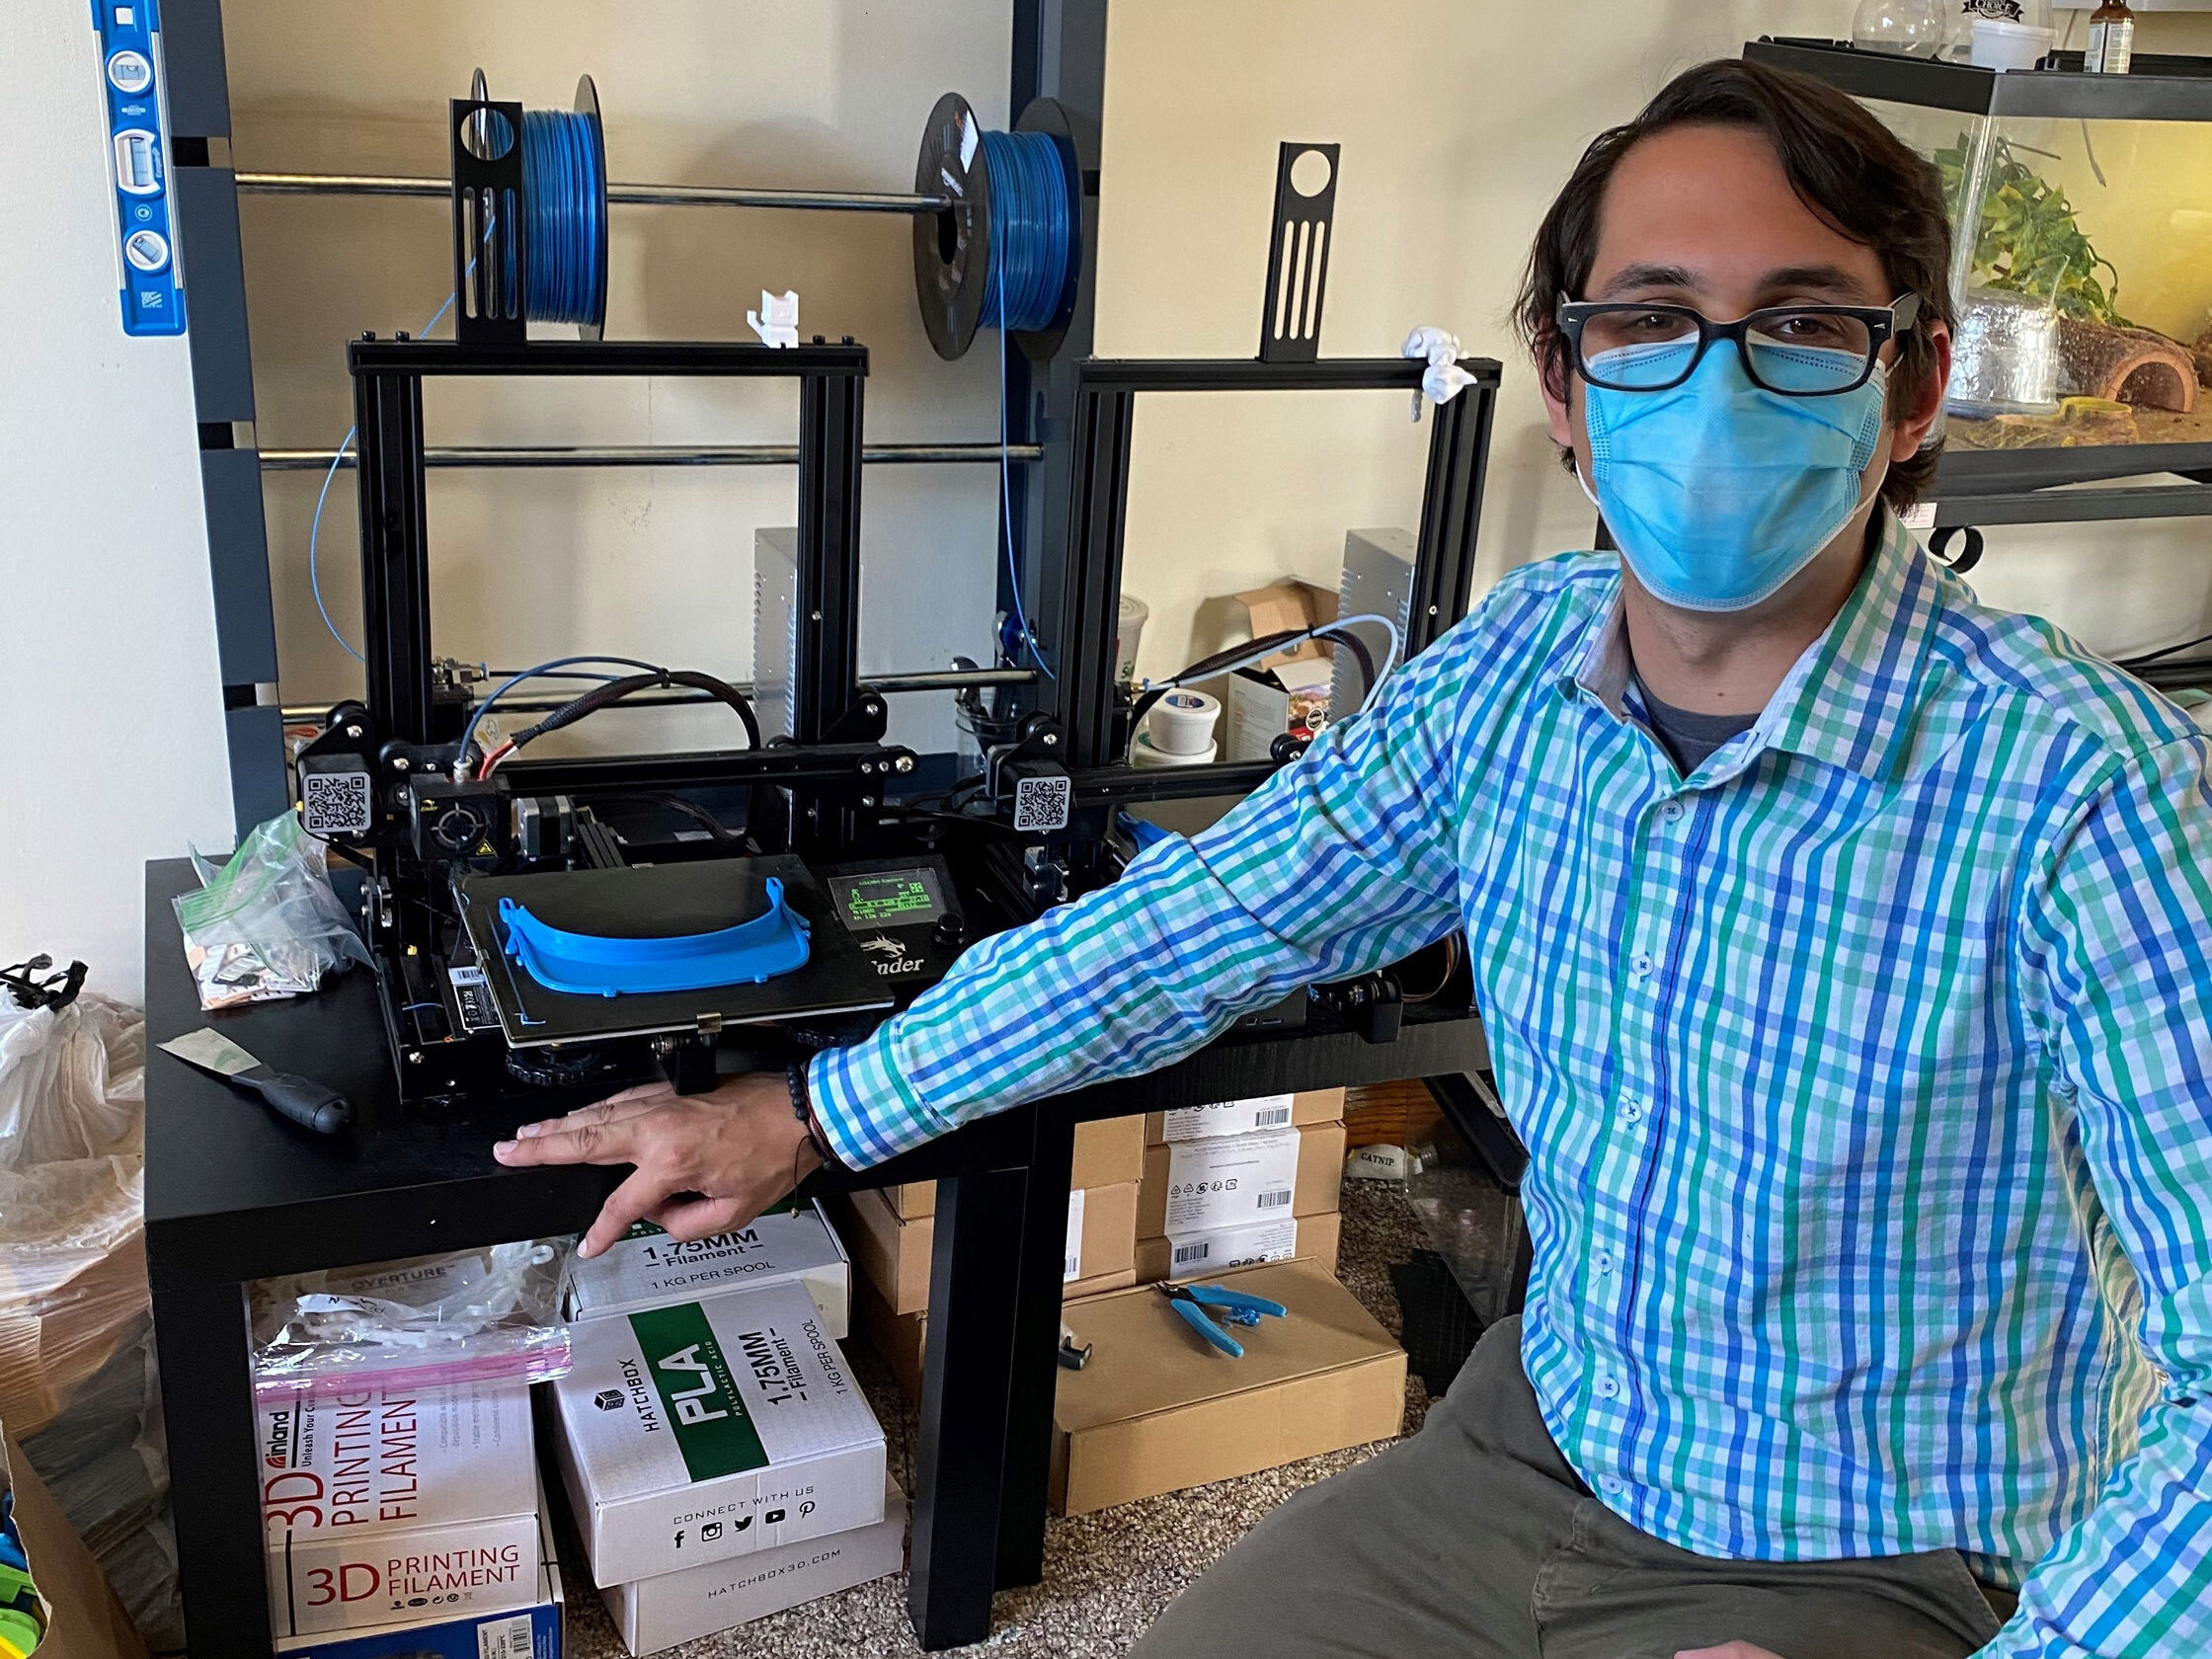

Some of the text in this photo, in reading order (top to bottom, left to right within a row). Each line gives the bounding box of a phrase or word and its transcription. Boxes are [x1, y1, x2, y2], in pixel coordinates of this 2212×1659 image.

[1976, 0, 2013, 12] CHOICE
[871, 957, 924, 975] nder
[1361, 1152, 1394, 1166] CATNIP
[666, 1245, 747, 1267] Filament
[351, 1266, 447, 1291] OVERTURE
[665, 1276, 687, 1287] KG
[690, 1270, 722, 1284] PER
[724, 1260, 776, 1276] SPOOL
[802, 1318, 827, 1351] SPOOL
[738, 1331, 793, 1405] 1.75MM
[771, 1338, 807, 1389] Filament
[817, 1351, 837, 1371] PER
[619, 1358, 661, 1432] HATCHBOX
[658, 1343, 729, 1426] PLA
[828, 1372, 845, 1387] KG
[266, 1411, 289, 1458] inland
[304, 1414, 315, 1434] Your
[301, 1434, 314, 1467] Unleash
[331, 1387, 371, 1527] PRINTING
[379, 1379, 418, 1522] FILAMENT
[265, 1471, 324, 1528] 3D
[673, 1486, 815, 1525] CONNECT WITH US
[307, 1544, 519, 1607] 3D PRINTING
[388, 1564, 520, 1596] FILAMENT
[708, 1549, 841, 1599] HATCHBOX3D.COM
